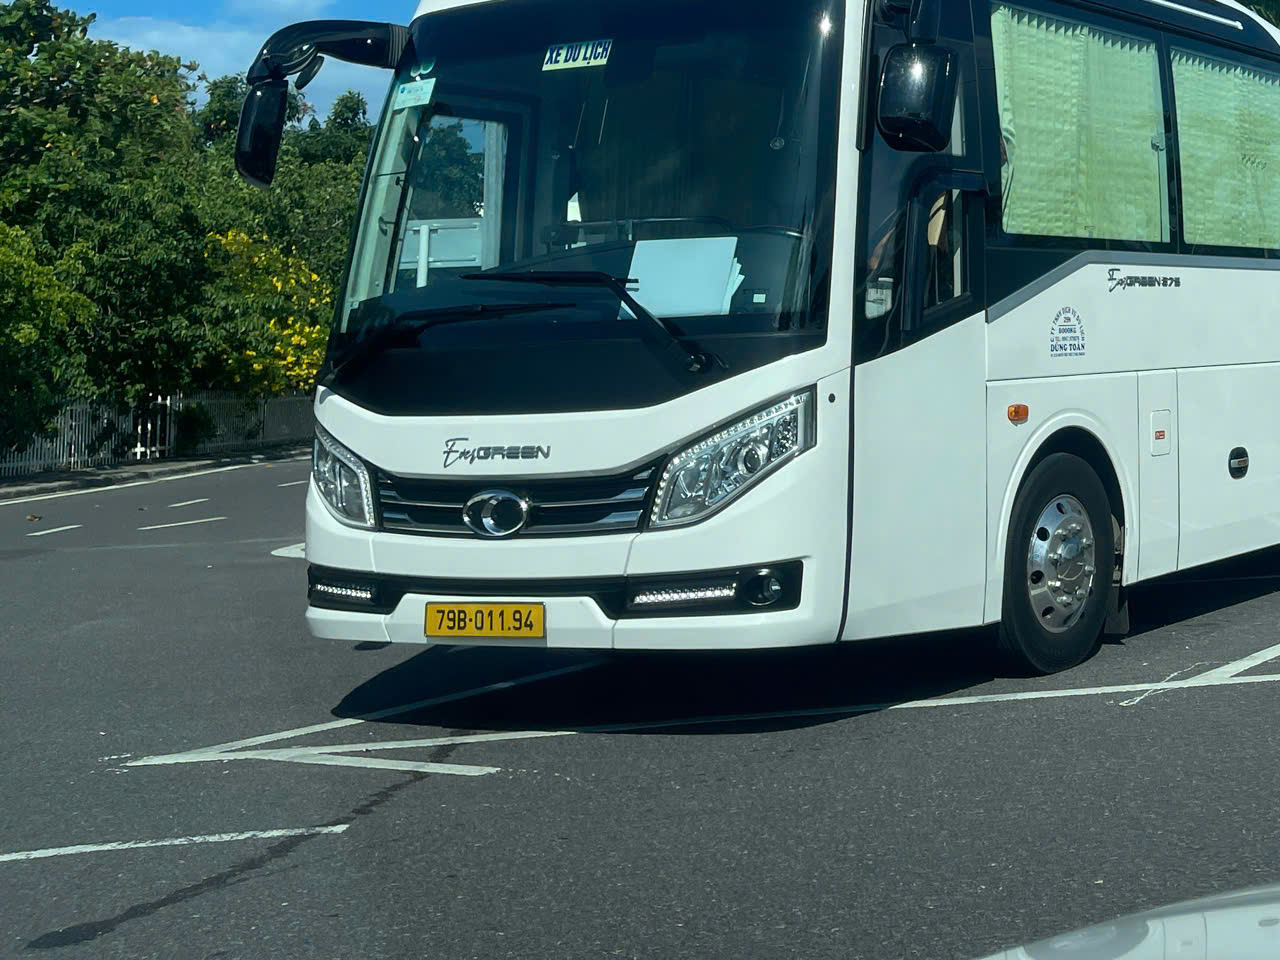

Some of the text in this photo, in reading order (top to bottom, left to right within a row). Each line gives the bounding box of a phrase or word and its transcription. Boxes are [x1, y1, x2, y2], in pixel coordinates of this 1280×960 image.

[545, 40, 611, 65] XE DU LỊCH
[436, 609, 534, 632] 79B-011.94
